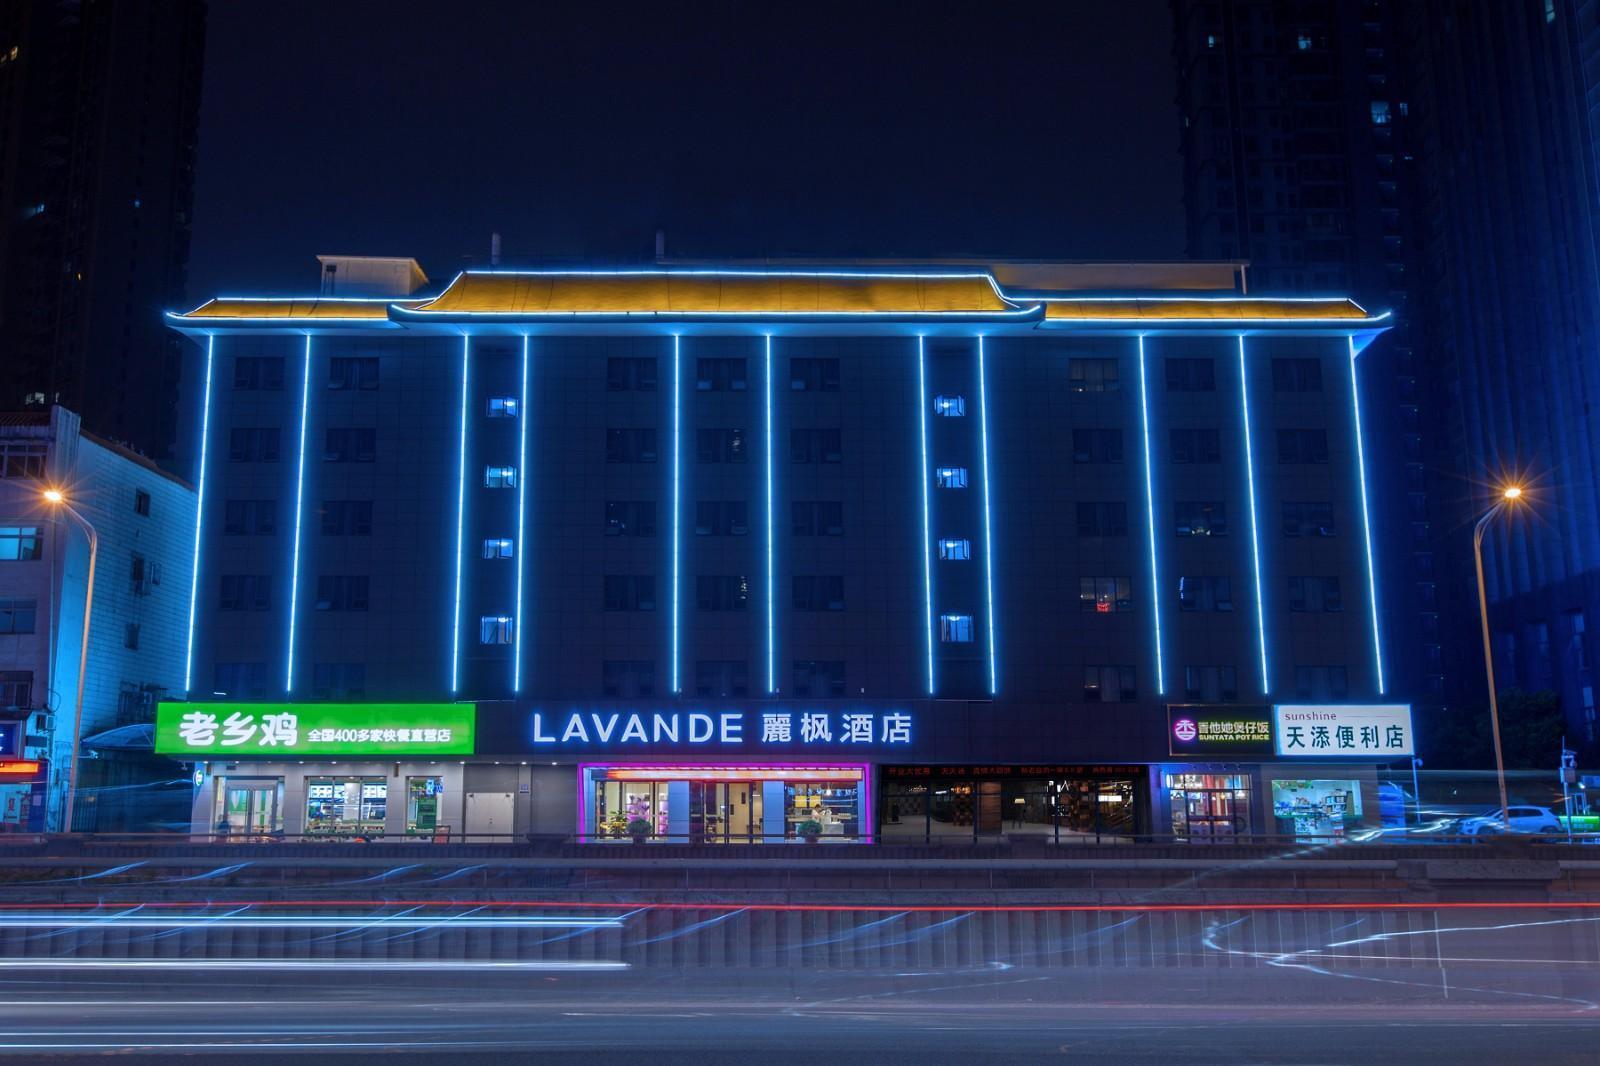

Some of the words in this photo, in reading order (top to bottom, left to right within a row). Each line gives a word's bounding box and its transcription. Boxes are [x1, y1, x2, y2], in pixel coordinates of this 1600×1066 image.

[179, 711, 299, 747] 老乡鸡
[533, 713, 744, 743] LAVANDE
[761, 712, 912, 743] 麗枫酒店
[1284, 711, 1337, 721] sunshine
[307, 728, 452, 743] 全国400多家快餐直营店
[1286, 724, 1404, 749] 天添便利店
